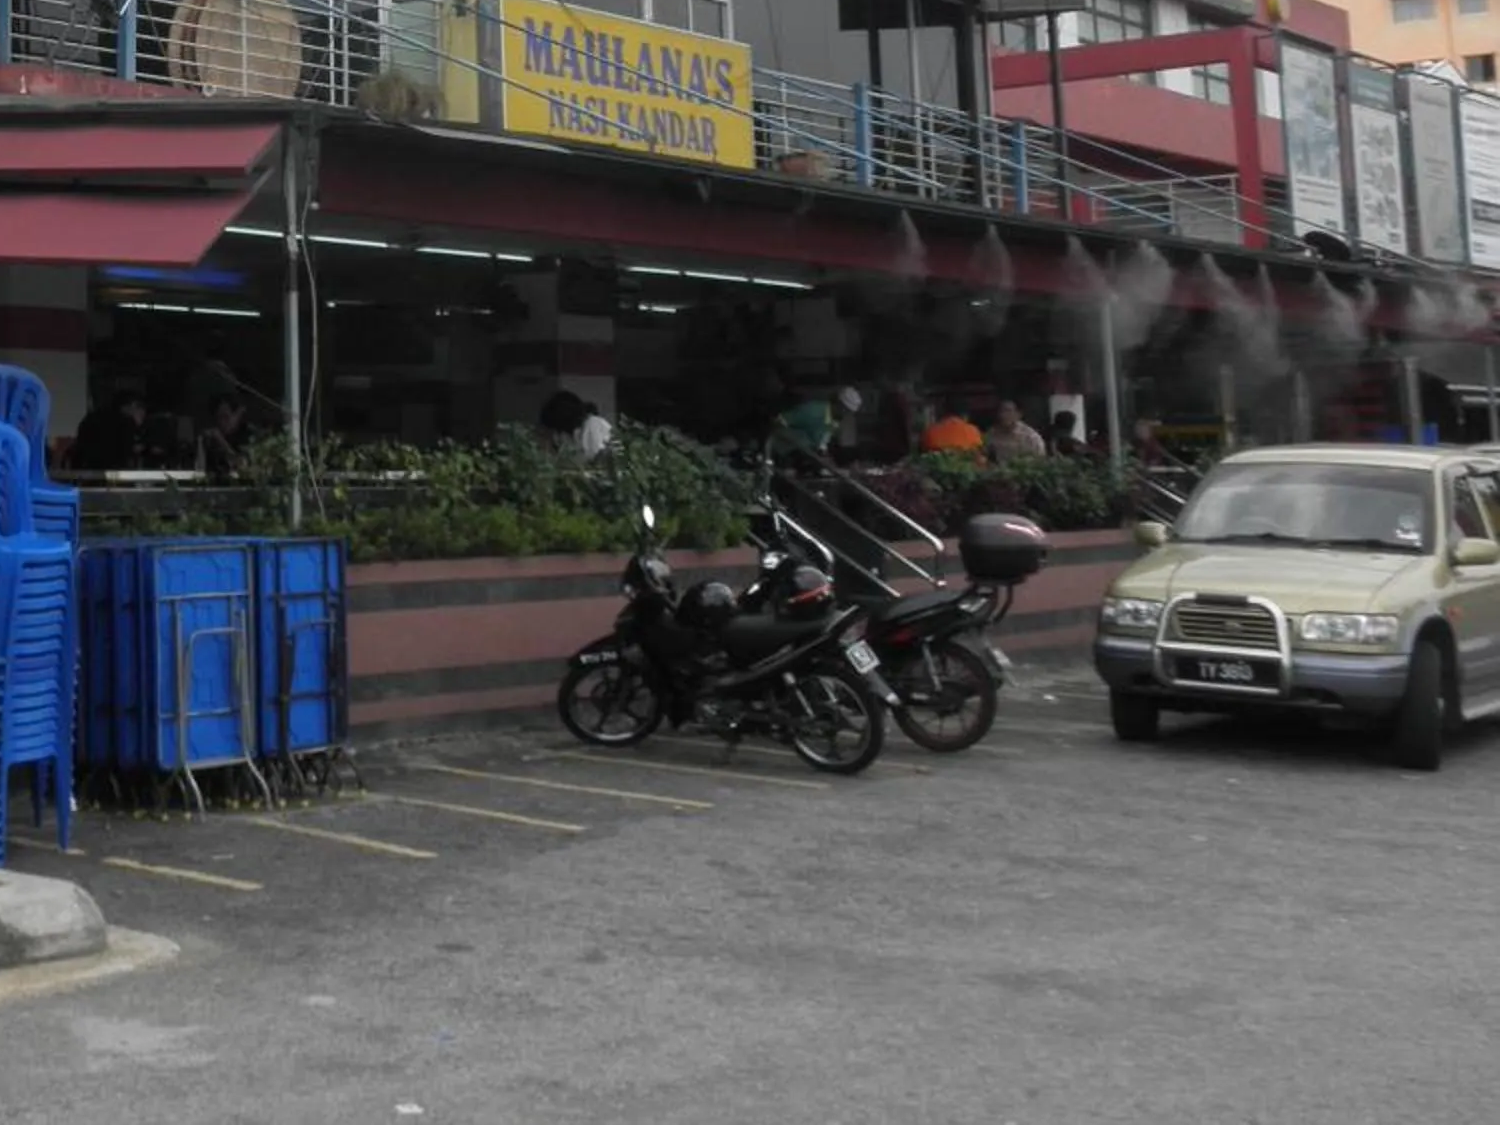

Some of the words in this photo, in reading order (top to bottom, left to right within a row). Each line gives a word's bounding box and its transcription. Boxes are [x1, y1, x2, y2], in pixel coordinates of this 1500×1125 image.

[523, 16, 736, 106] MAULANA'S
[547, 88, 609, 138] NASI
[615, 100, 718, 157] KANDAR
